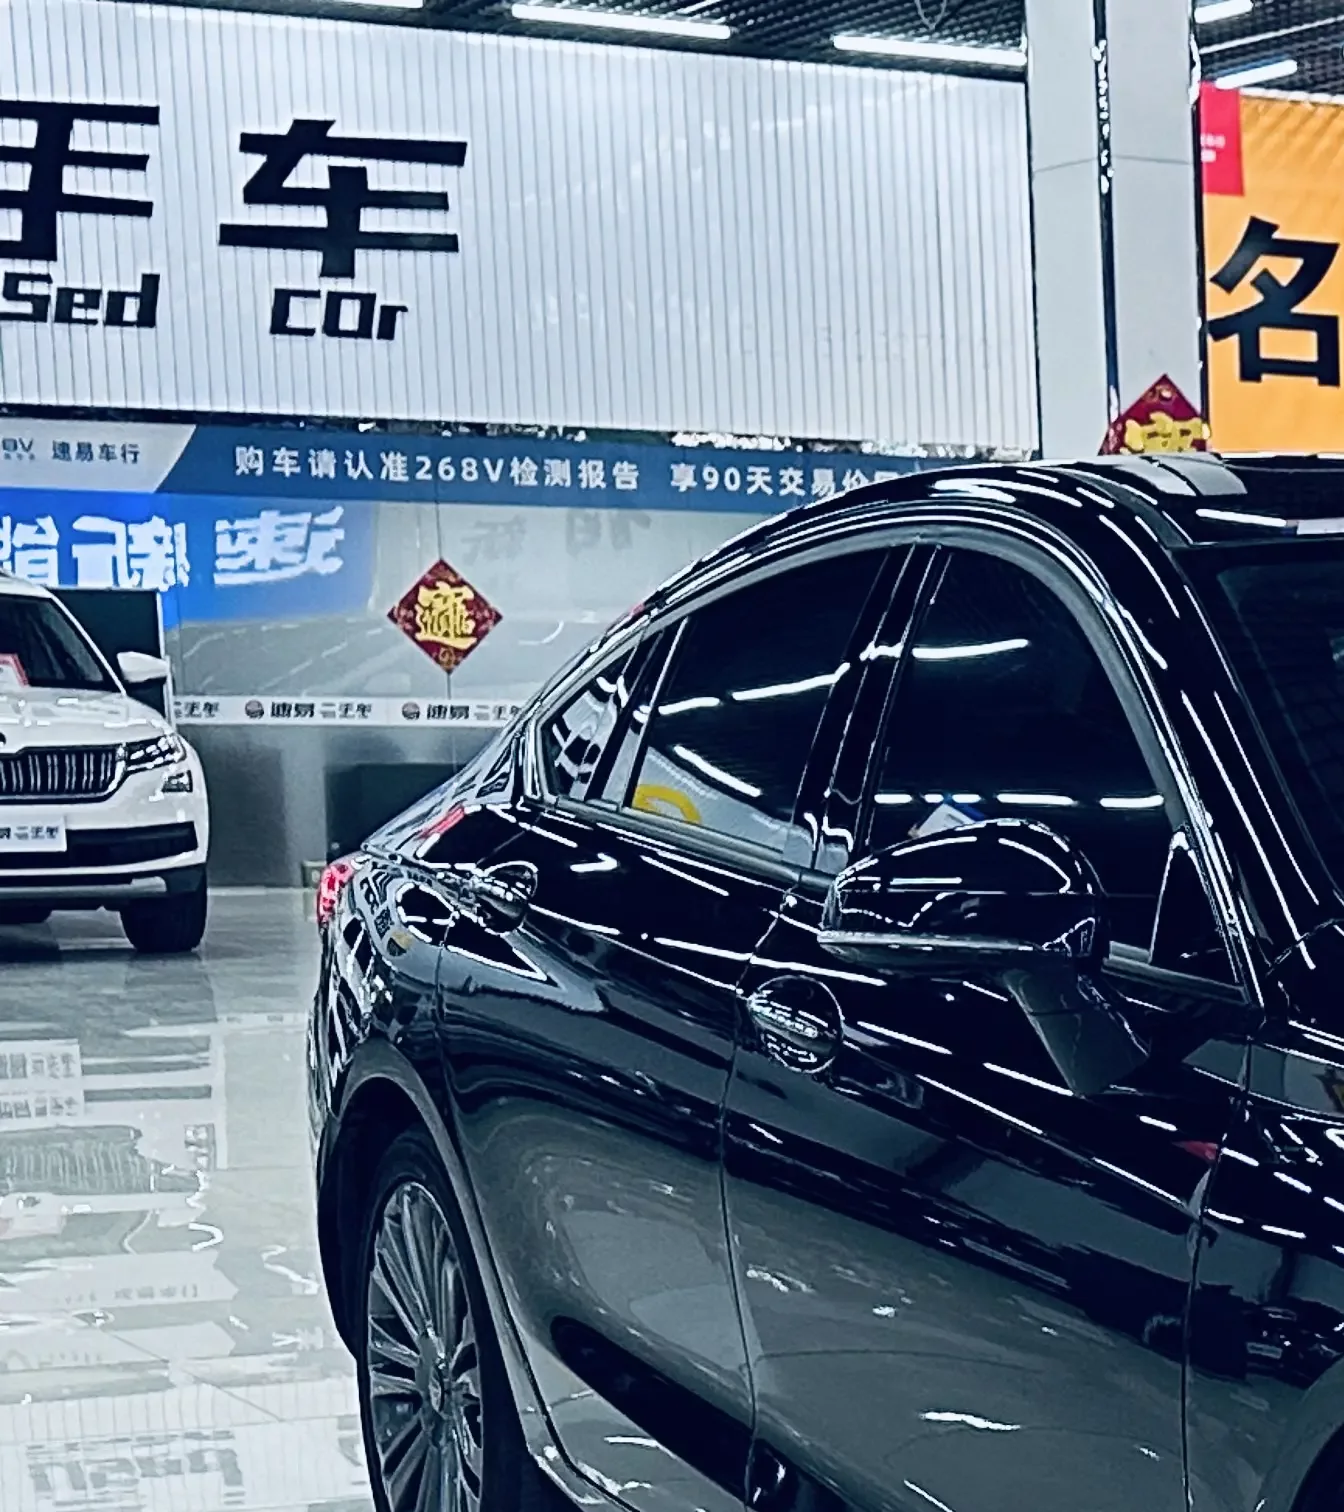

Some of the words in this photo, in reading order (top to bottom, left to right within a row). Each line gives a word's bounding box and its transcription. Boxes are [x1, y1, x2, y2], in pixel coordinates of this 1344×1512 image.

[235, 446, 639, 491] 购车请认准268V检测报告
